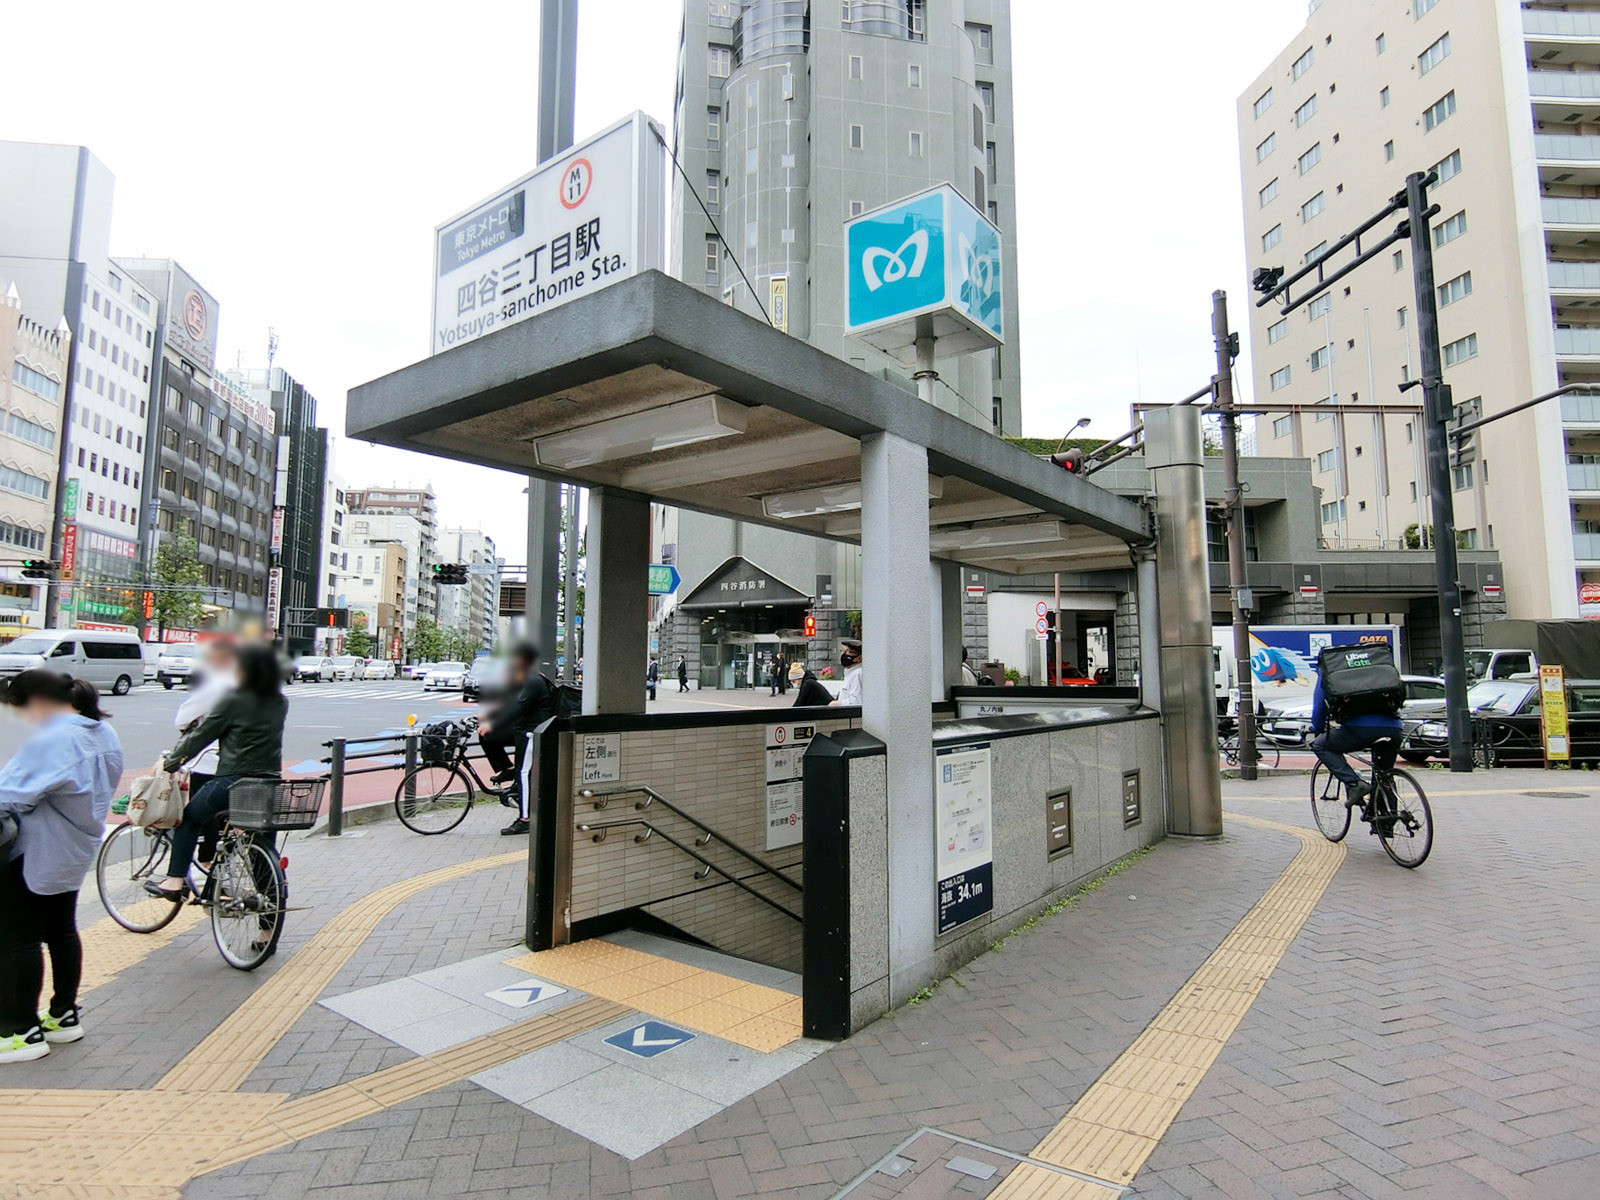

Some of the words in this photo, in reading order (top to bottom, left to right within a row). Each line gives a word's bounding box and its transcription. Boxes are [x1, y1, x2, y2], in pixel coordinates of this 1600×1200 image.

[570, 168, 581, 183] M
[568, 182, 582, 200] 11
[454, 206, 510, 250] 東京メトロ
[457, 240, 480, 262] Tokyo
[481, 231, 506, 254] Metro
[457, 216, 601, 318] 四谷三丁目駅
[439, 271, 585, 348] Yotsuya-sanchome
[591, 253, 627, 281] Sta.
[720, 579, 767, 591] 四谷消防署
[1359, 635, 1388, 643] DATA
[1345, 652, 1369, 661] Uber
[1347, 660, 1371, 668] Eats
[585, 737, 605, 745] ここでは
[585, 770, 601, 780] Left
[957, 882, 983, 903] 34.1m
